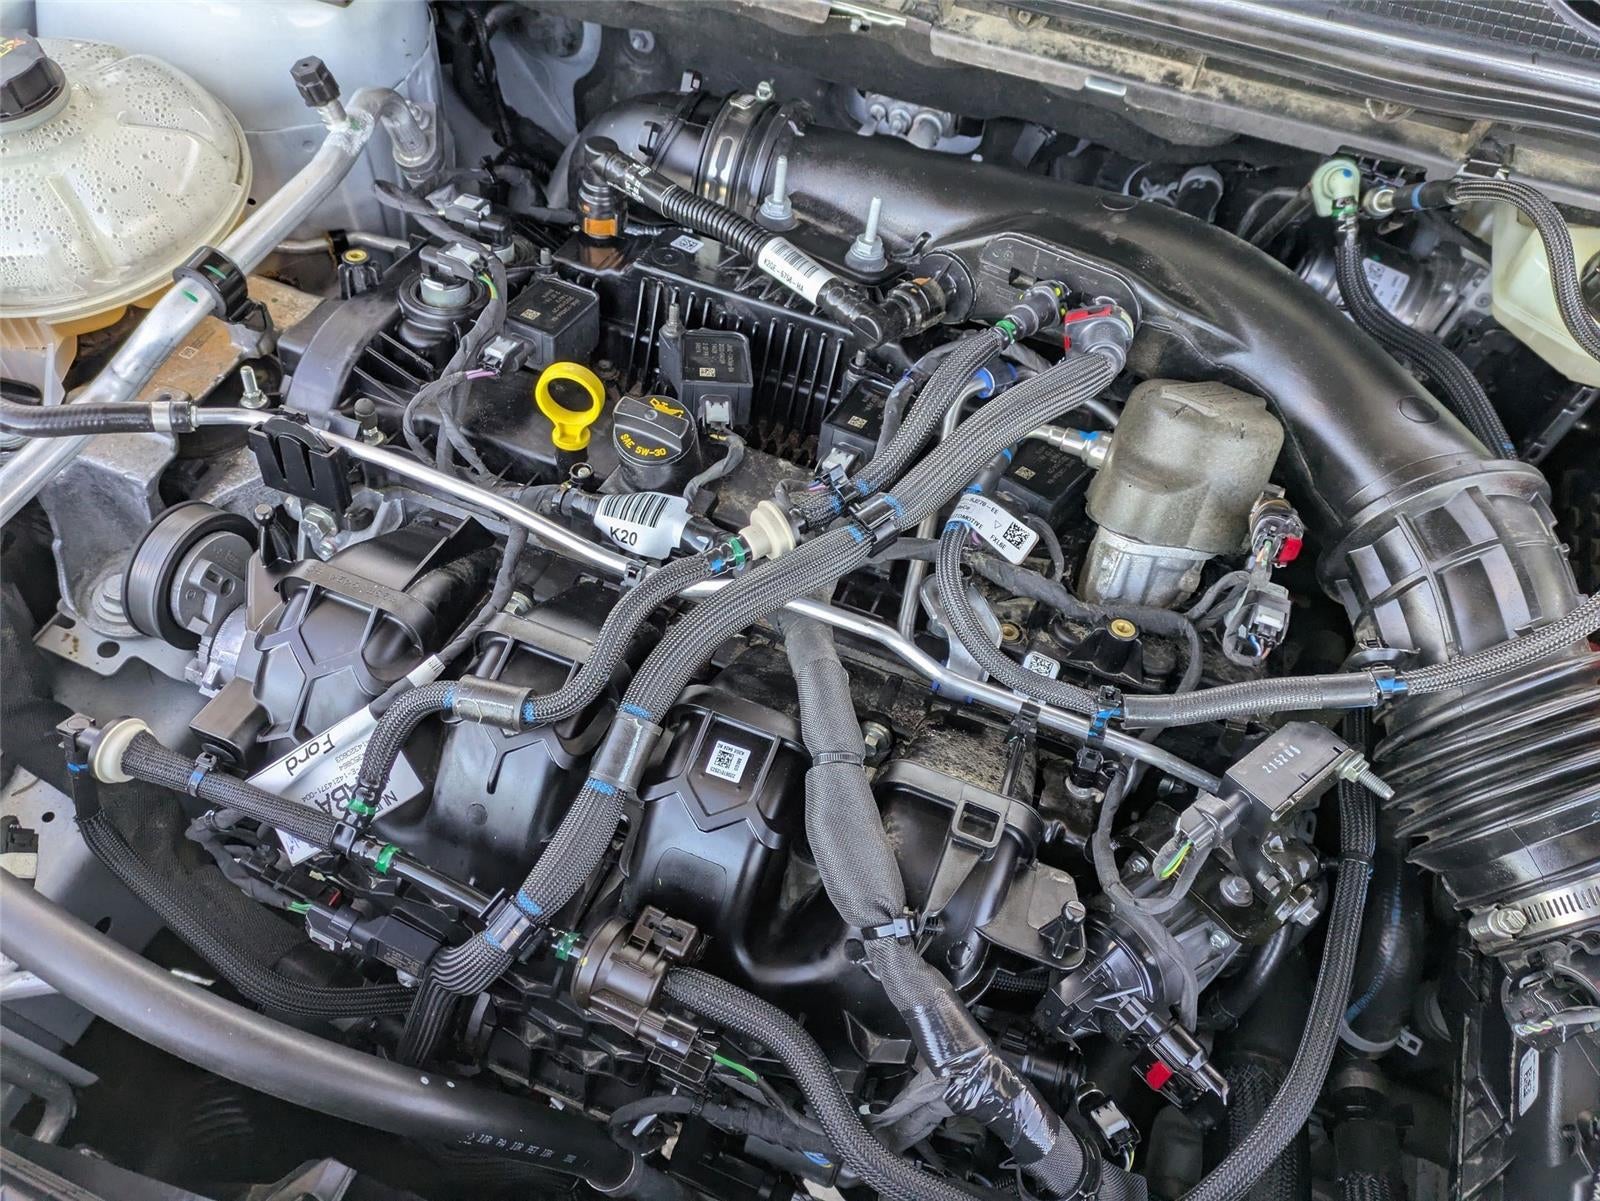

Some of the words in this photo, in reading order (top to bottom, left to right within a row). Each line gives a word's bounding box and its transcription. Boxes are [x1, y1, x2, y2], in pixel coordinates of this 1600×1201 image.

[620, 433, 635, 449] SAE
[635, 446, 667, 457] 5W-30
[610, 526, 638, 546] K20
[285, 733, 336, 777] Ford
